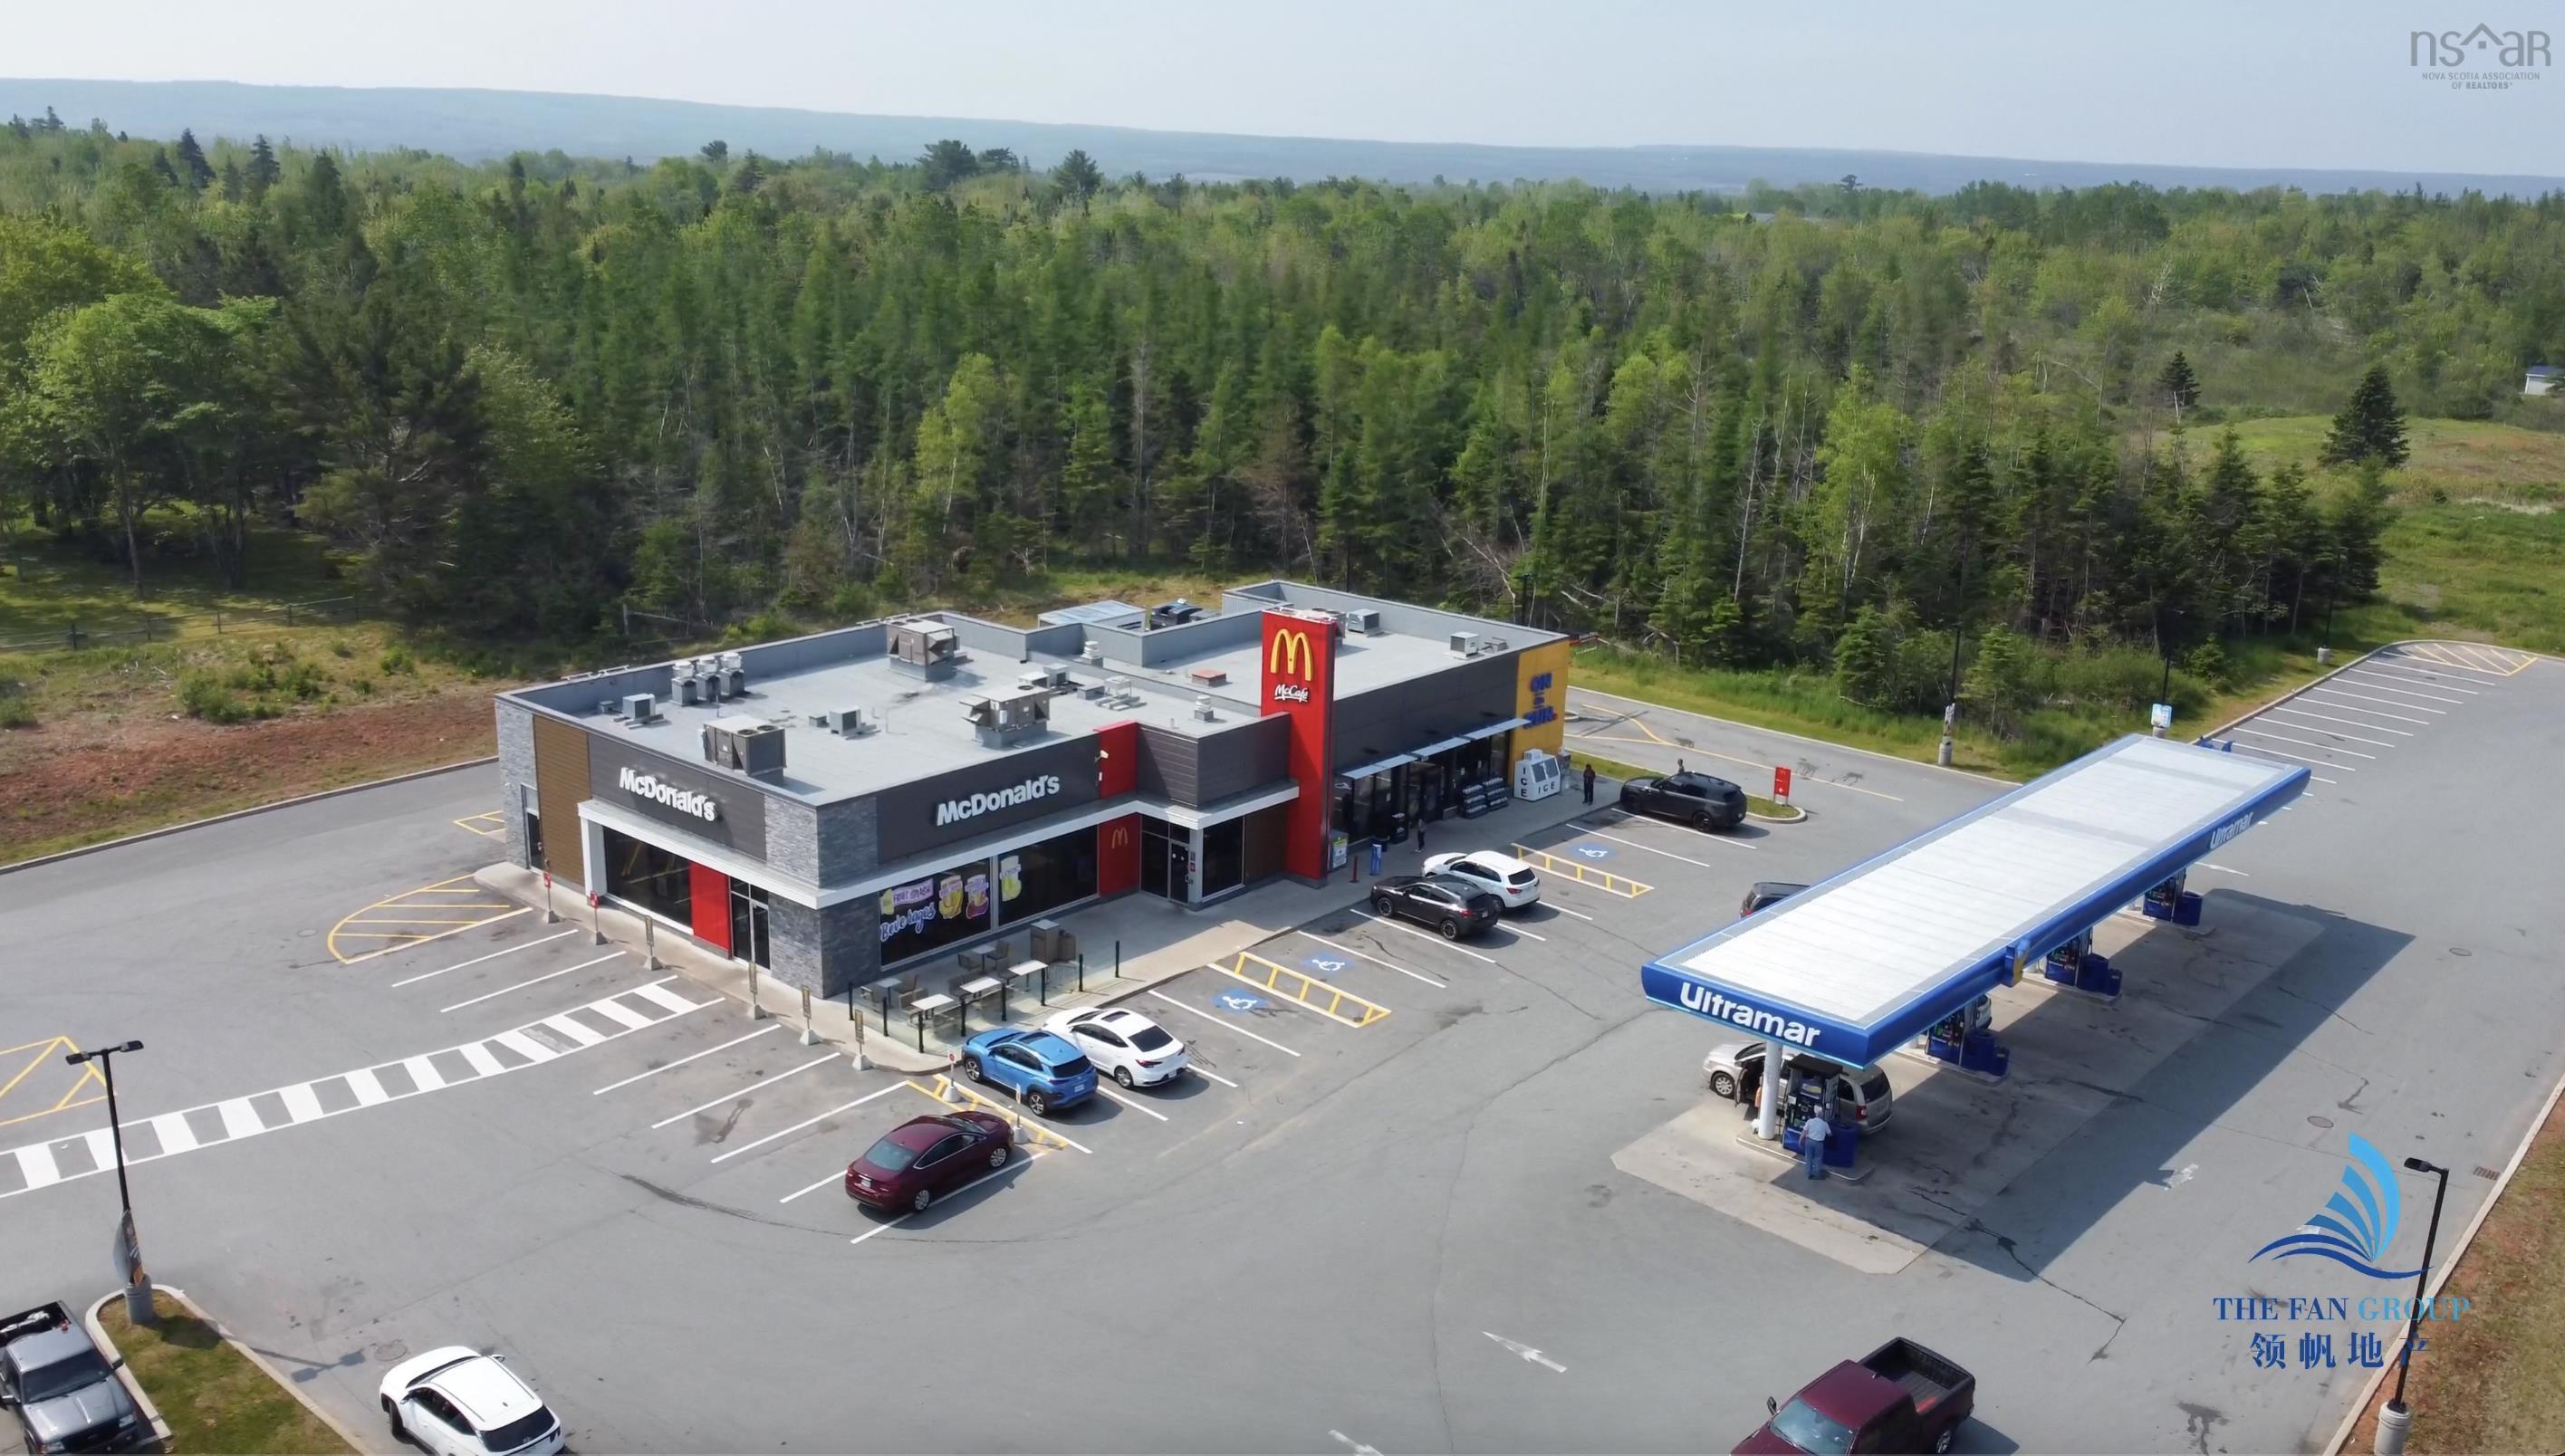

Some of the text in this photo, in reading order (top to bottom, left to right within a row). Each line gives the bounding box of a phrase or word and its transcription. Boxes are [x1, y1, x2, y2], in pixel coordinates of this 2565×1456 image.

[619, 767, 716, 822] McDonald's
[937, 775, 1061, 827] McDonald's
[1520, 766, 1528, 798] ICE
[1538, 781, 1556, 795] ICE
[1680, 982, 1820, 1047] Ultramar
